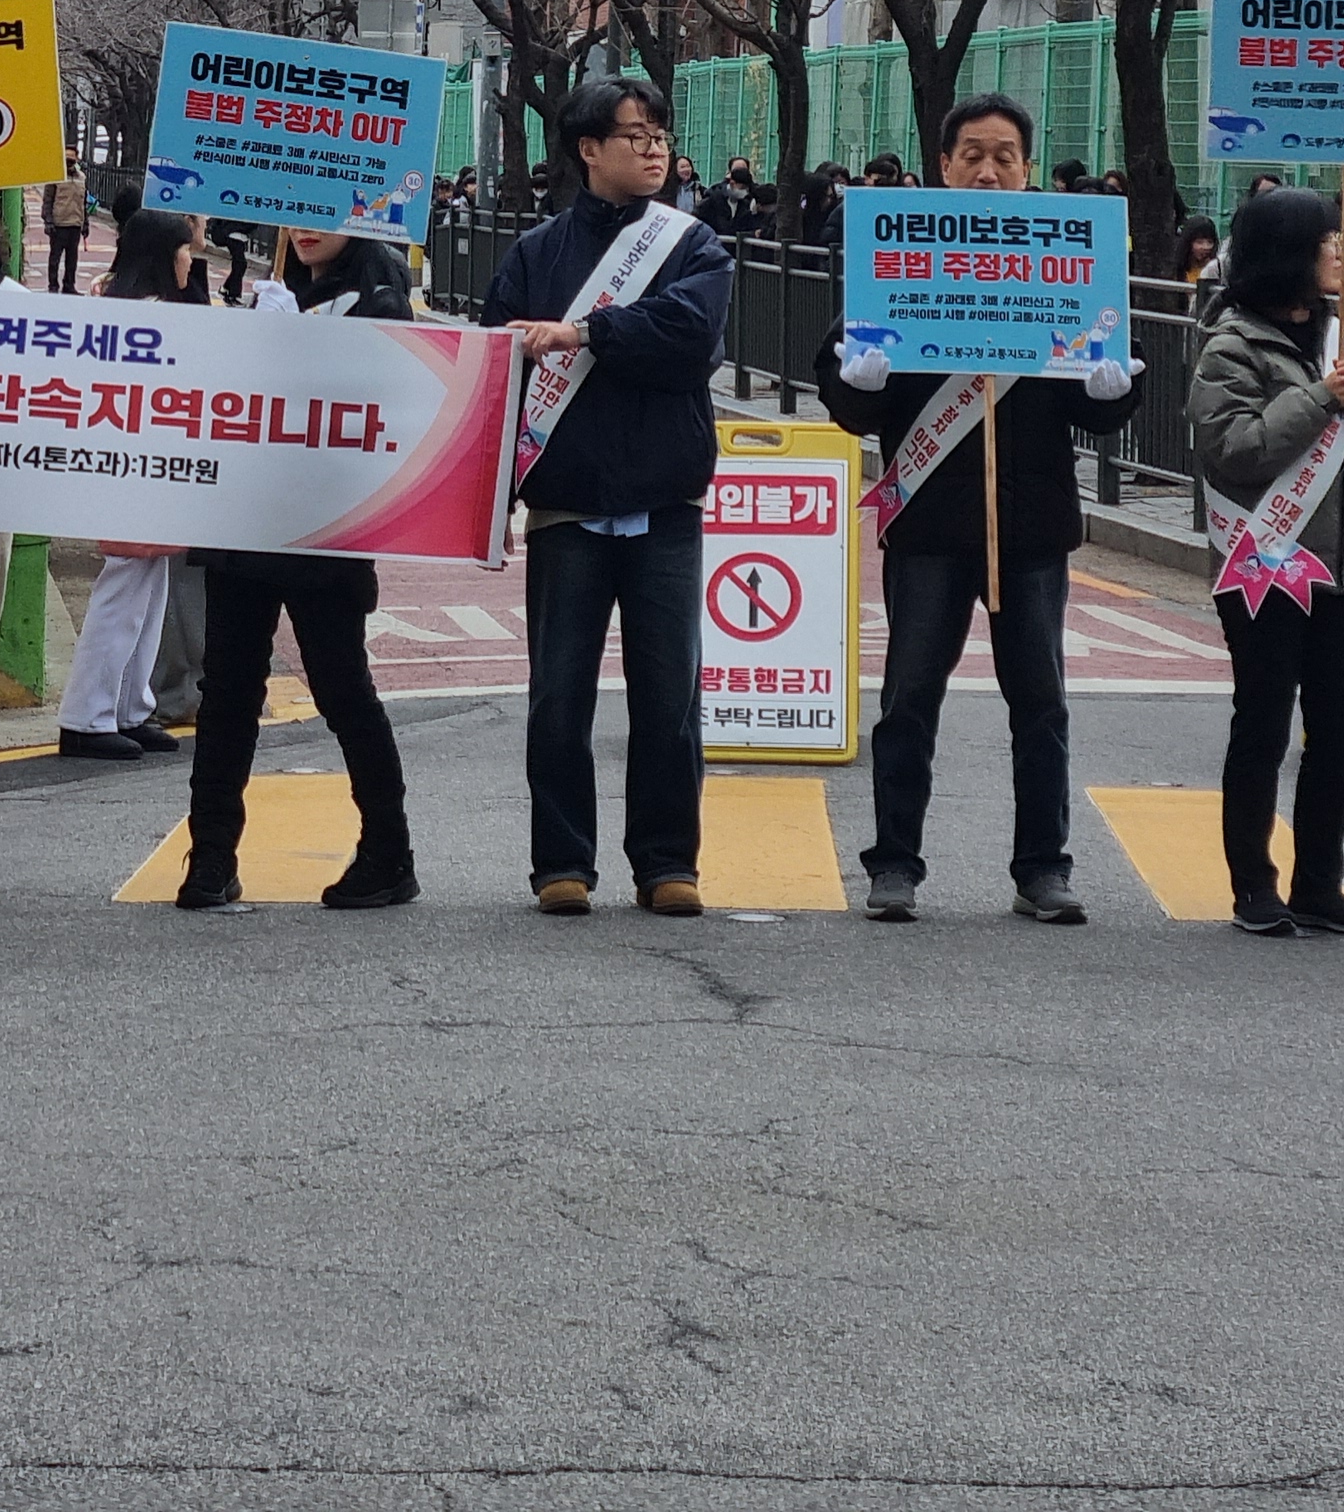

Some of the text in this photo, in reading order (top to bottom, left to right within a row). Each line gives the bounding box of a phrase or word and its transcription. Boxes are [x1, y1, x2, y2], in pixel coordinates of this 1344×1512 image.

[1239, 37, 1297, 68] 불법
[190, 52, 410, 110] 어린이보호구역
[185, 90, 408, 146] 불법 주정차 OUT
[875, 213, 1093, 249] 어린이보호구역
[873, 250, 1095, 285] 불법 주정차 OUT
[531, 384, 562, 410] 그만
[905, 439, 929, 472] 그만
[913, 427, 941, 459] 이제
[1261, 508, 1293, 537] 그만
[1272, 494, 1304, 522] 이제
[702, 666, 832, 694] 량통행금지
[714, 707, 753, 728] 부탁
[757, 707, 836, 730] 드립니다
